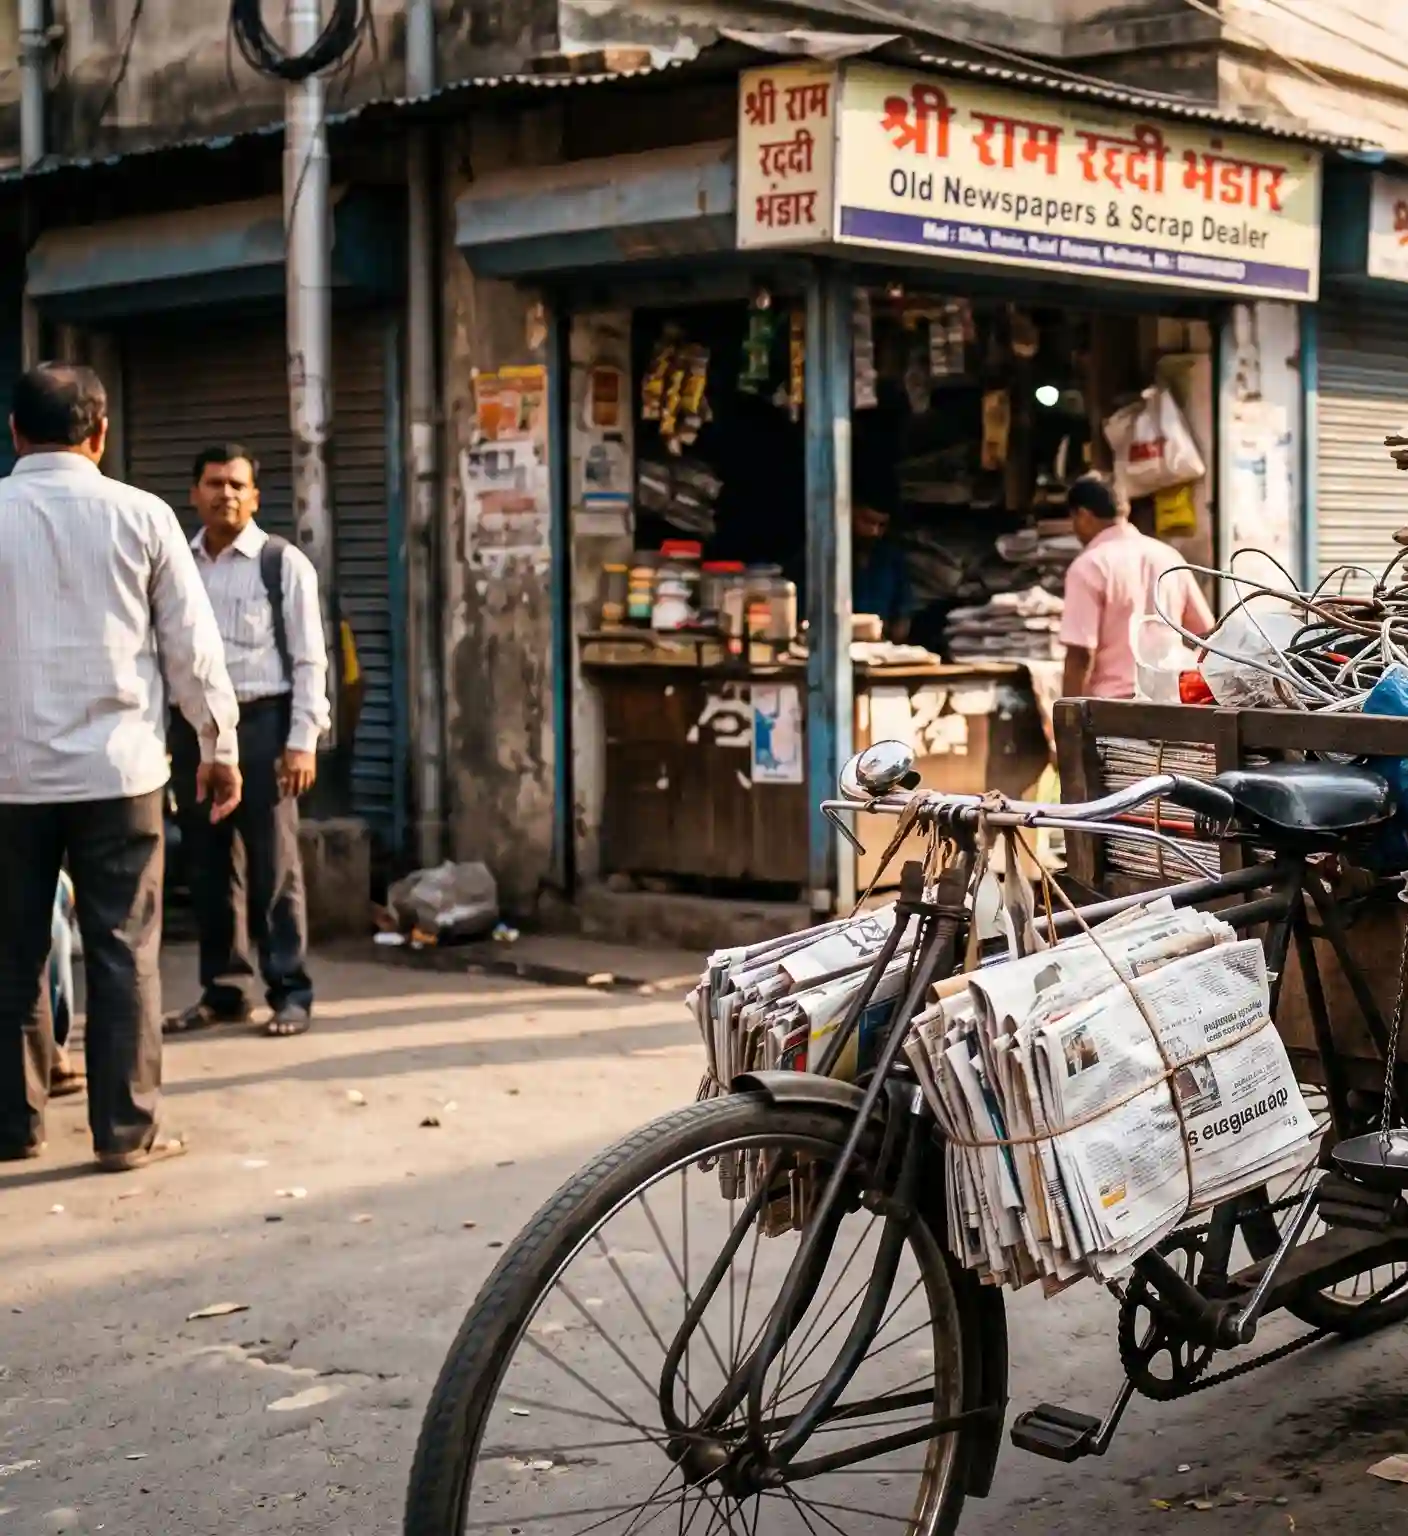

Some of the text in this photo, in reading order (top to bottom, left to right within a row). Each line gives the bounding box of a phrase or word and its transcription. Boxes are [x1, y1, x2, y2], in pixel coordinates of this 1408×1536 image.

[744, 78, 830, 125] श्री राम
[880, 83, 956, 157] श्री
[970, 111, 1064, 174] राम
[1183, 138, 1288, 211] भंडार
[755, 182, 818, 228] भंडार
[890, 168, 1269, 250] Old Newspapers & Scrap Dealer
